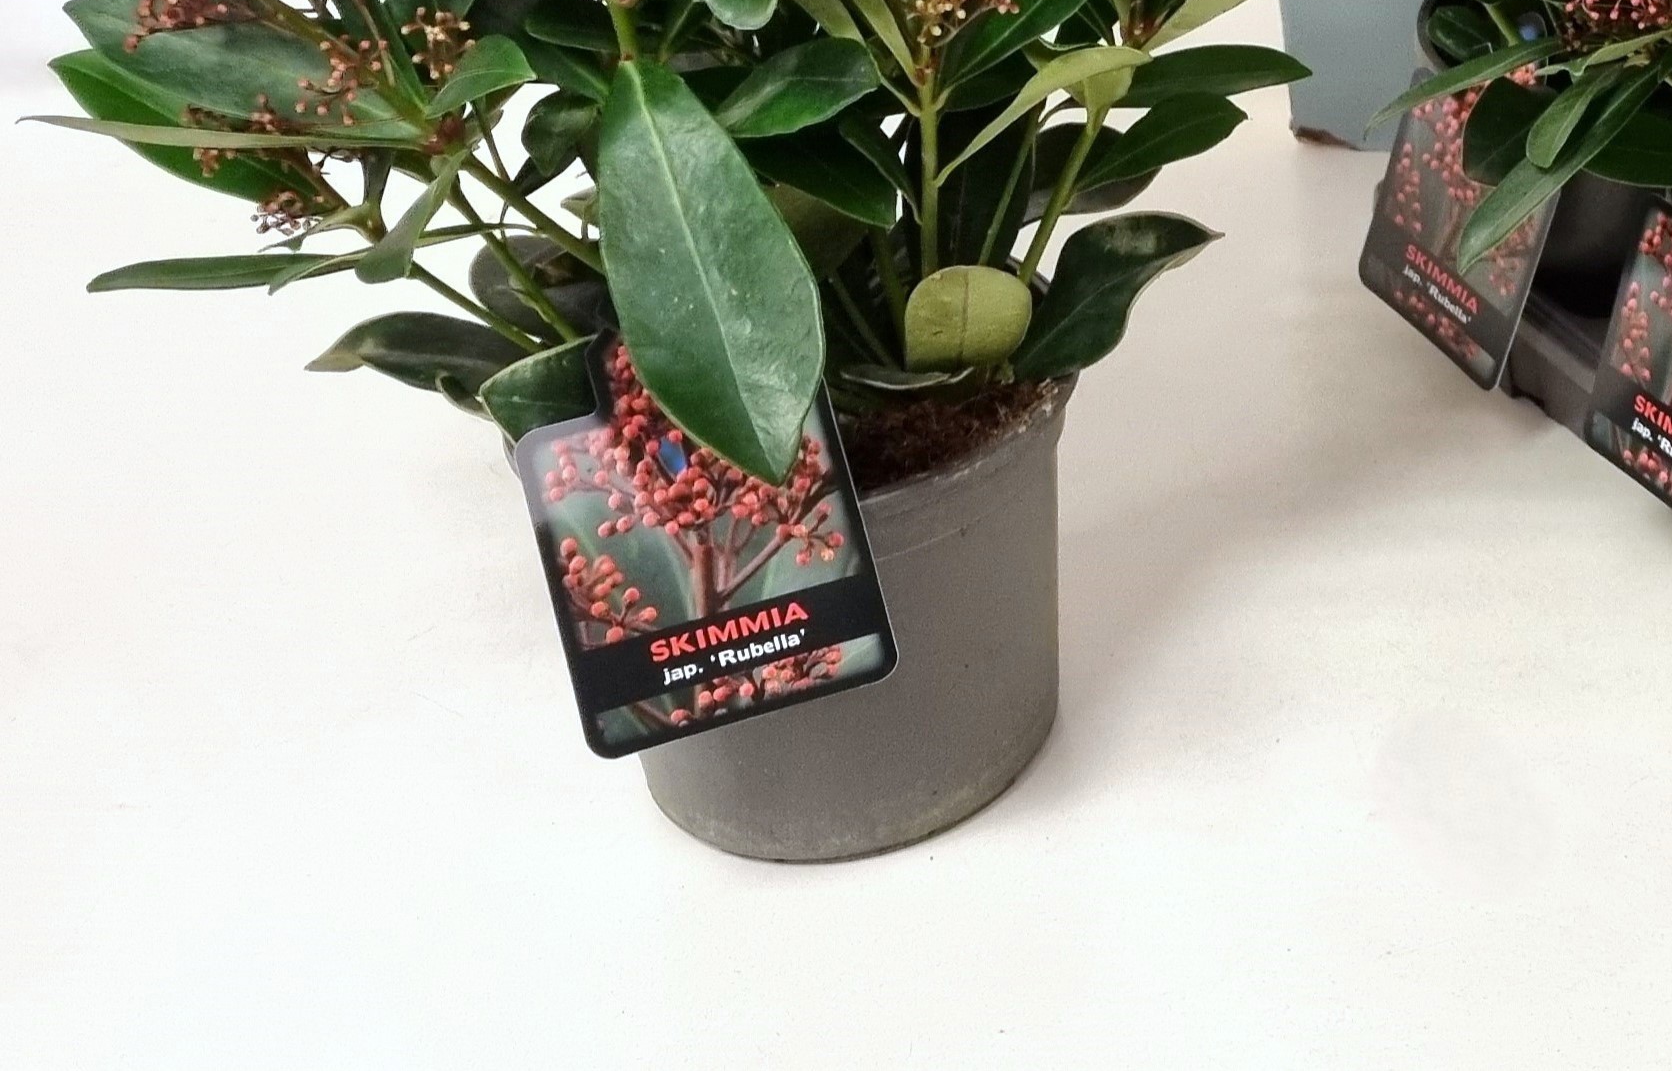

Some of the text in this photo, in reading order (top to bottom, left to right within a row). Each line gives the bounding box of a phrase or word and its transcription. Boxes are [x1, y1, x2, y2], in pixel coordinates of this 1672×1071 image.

[1406, 245, 1477, 314] SKIMMIA
[1632, 418, 1653, 442] jap.
[651, 603, 809, 662] SKIMMIA
[663, 629, 805, 685] jap. 'Rubella'
